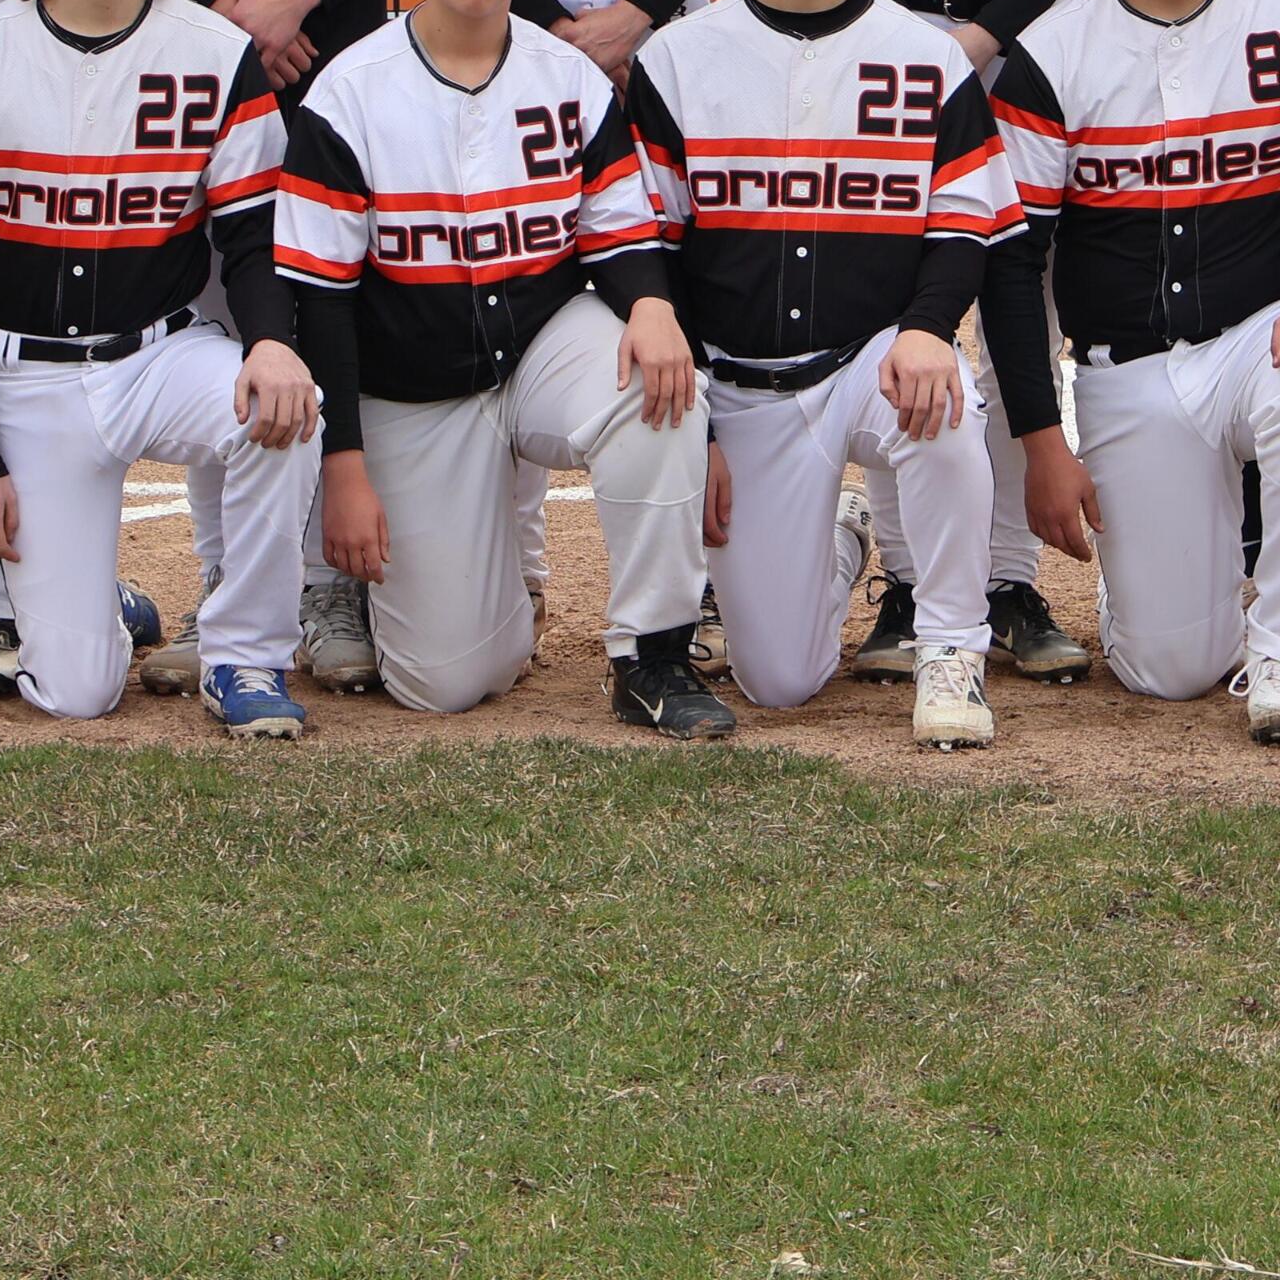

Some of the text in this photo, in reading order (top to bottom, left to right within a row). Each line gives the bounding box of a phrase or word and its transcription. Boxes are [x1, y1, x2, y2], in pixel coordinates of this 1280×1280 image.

[135, 74, 219, 149] 22
[857, 63, 944, 137] 23
[690, 162, 921, 212] orioles
